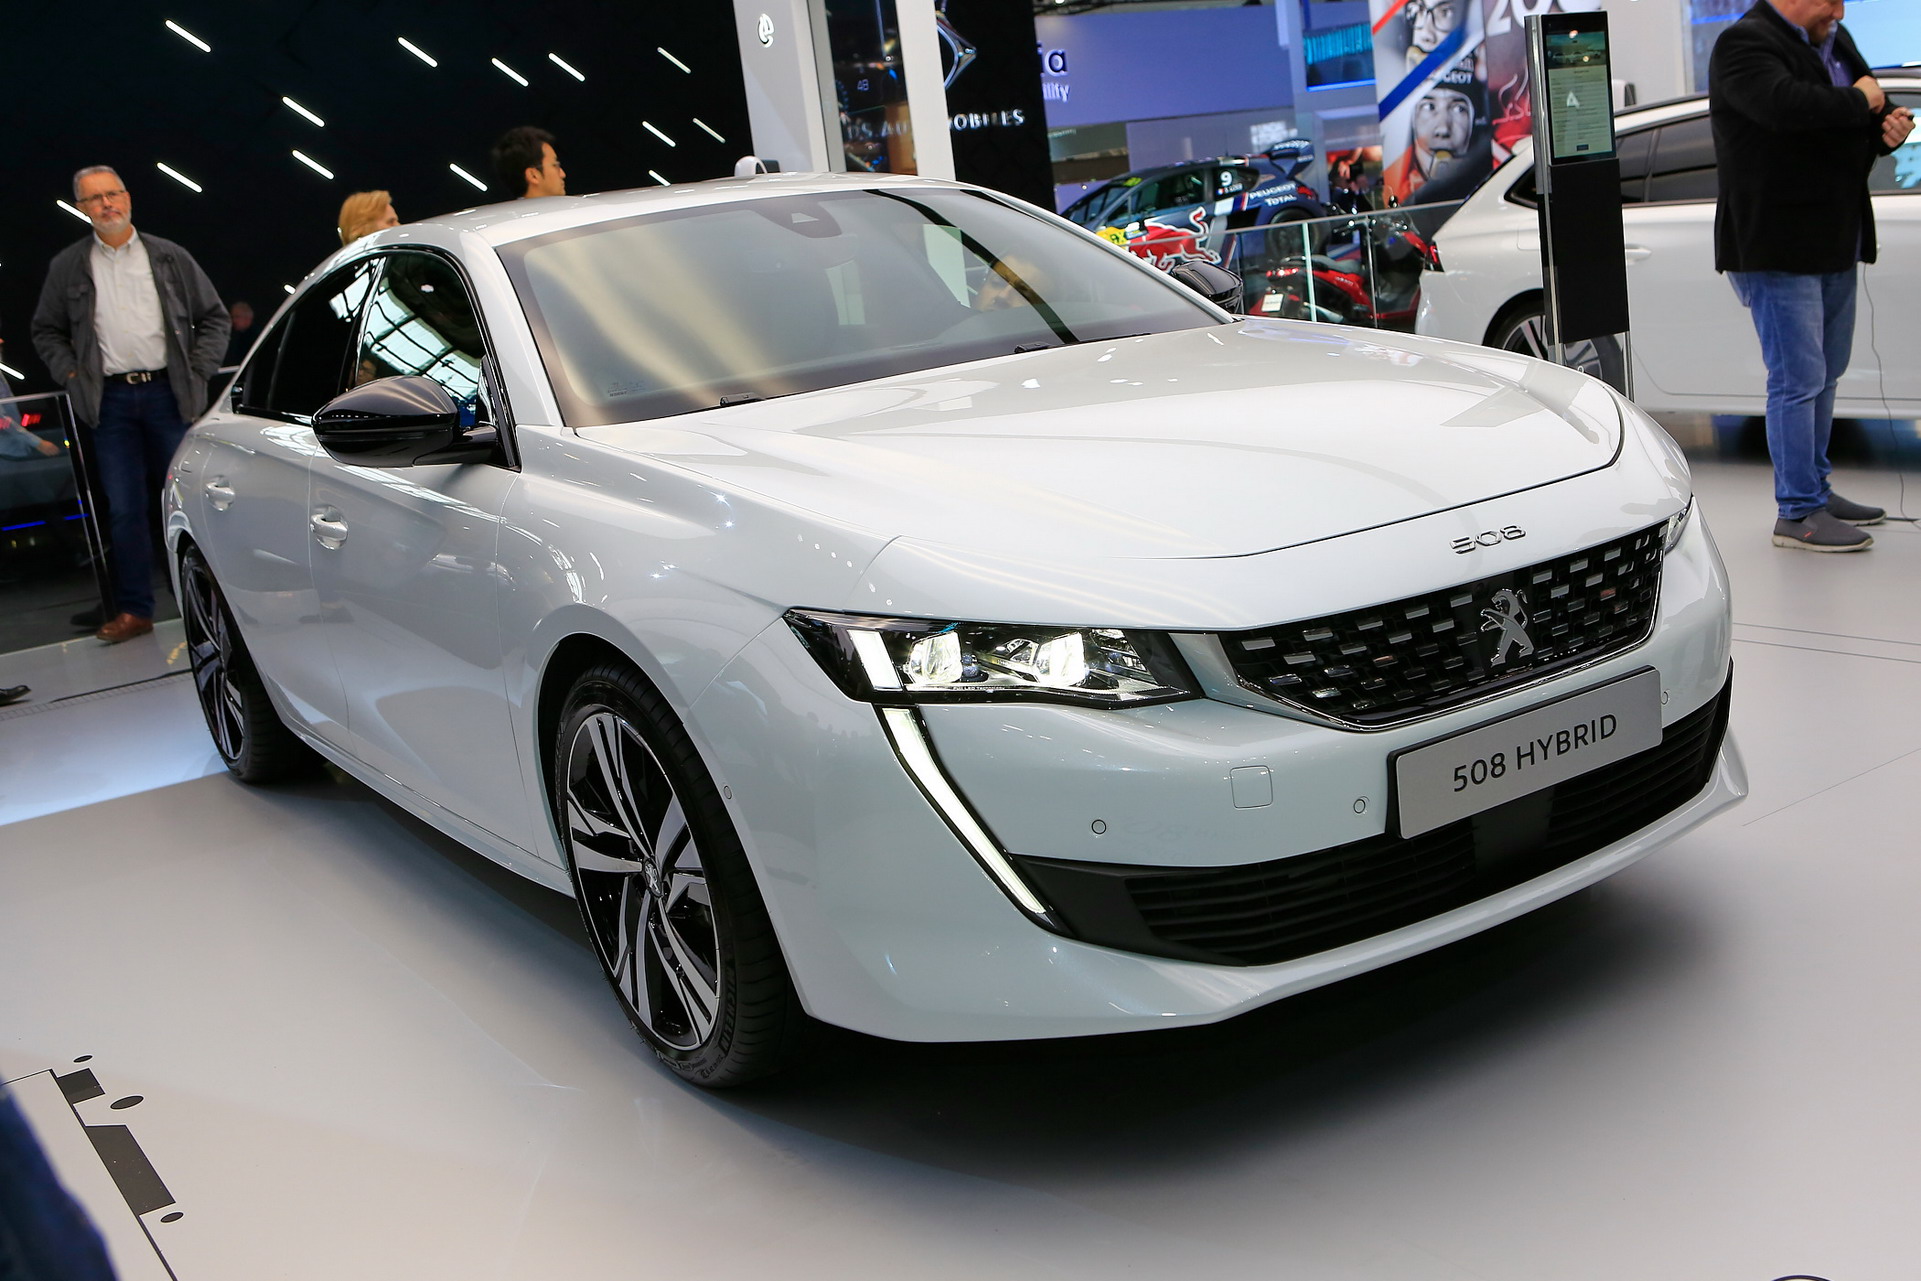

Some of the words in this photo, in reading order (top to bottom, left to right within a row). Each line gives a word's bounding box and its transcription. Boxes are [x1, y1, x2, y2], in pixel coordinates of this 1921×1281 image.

[1220, 171, 1233, 187] 9
[1249, 181, 1297, 199] PEUGEOT
[1264, 194, 1297, 206] TOTAL
[1450, 525, 1526, 554] 508
[1453, 752, 1507, 793] 508
[1516, 714, 1617, 770] HYBRID
[720, 965, 736, 1053] MICHELIN
